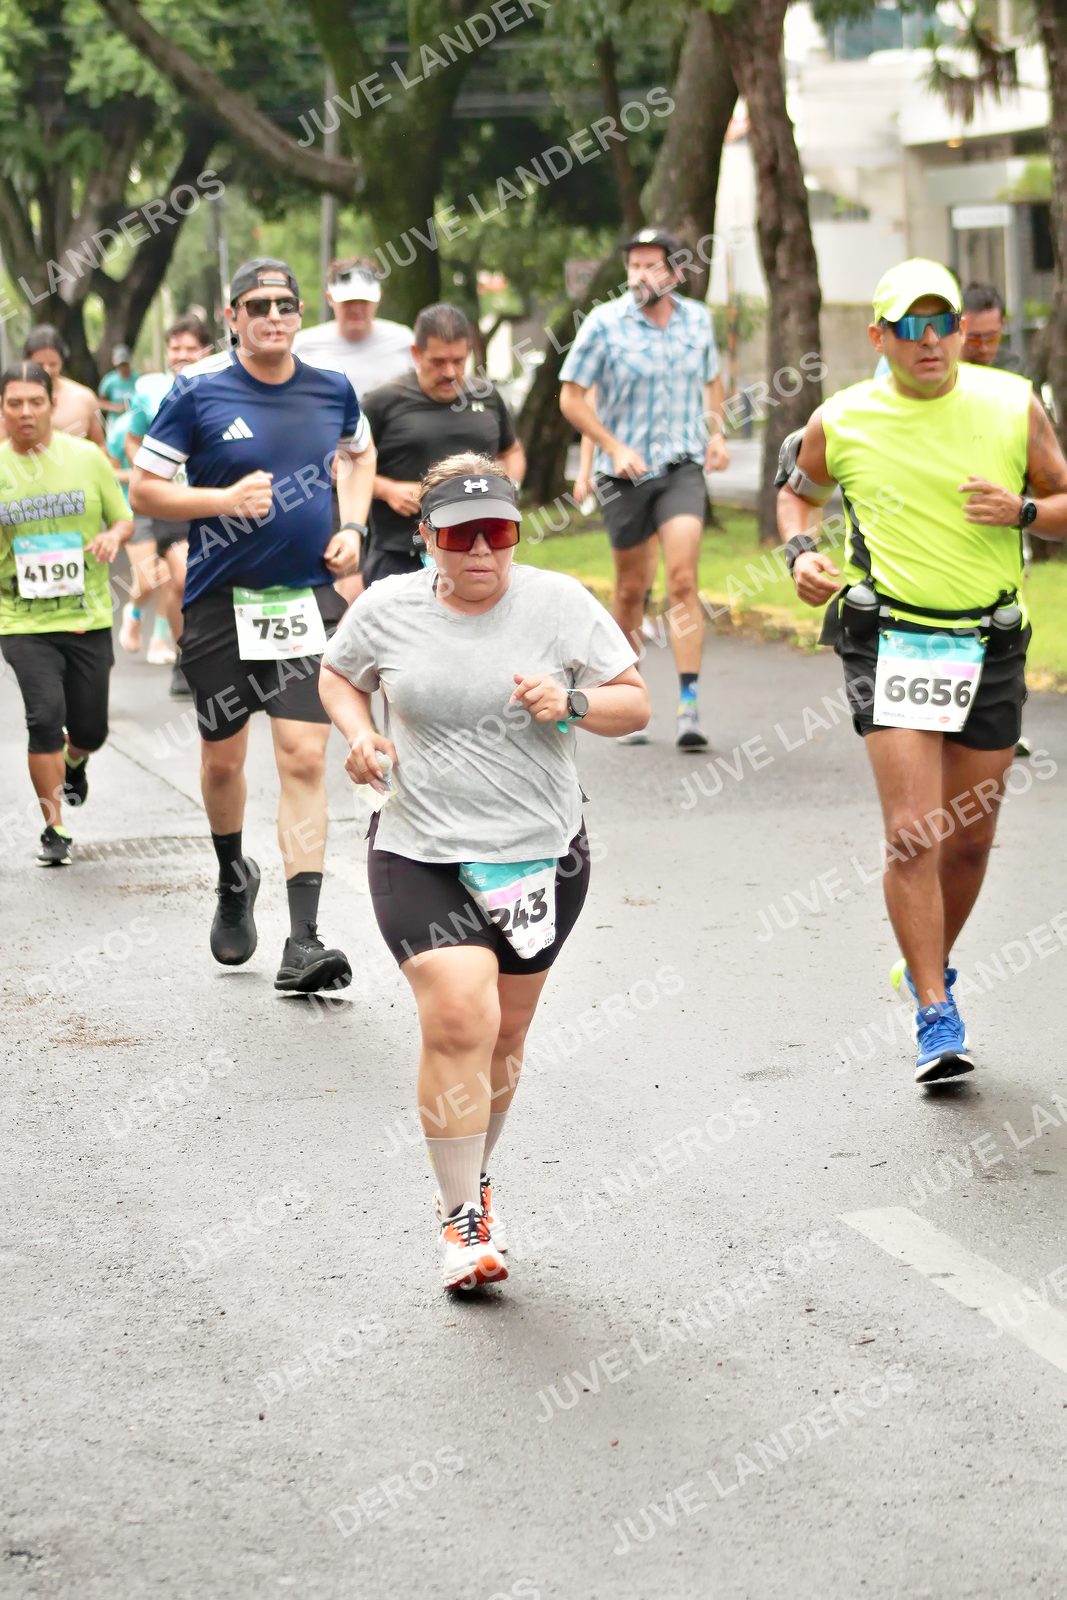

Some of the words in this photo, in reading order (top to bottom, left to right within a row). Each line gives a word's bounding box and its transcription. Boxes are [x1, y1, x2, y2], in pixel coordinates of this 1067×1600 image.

[24, 562, 79, 582] 4190
[252, 614, 308, 640] 735
[884, 675, 972, 708] 6656
